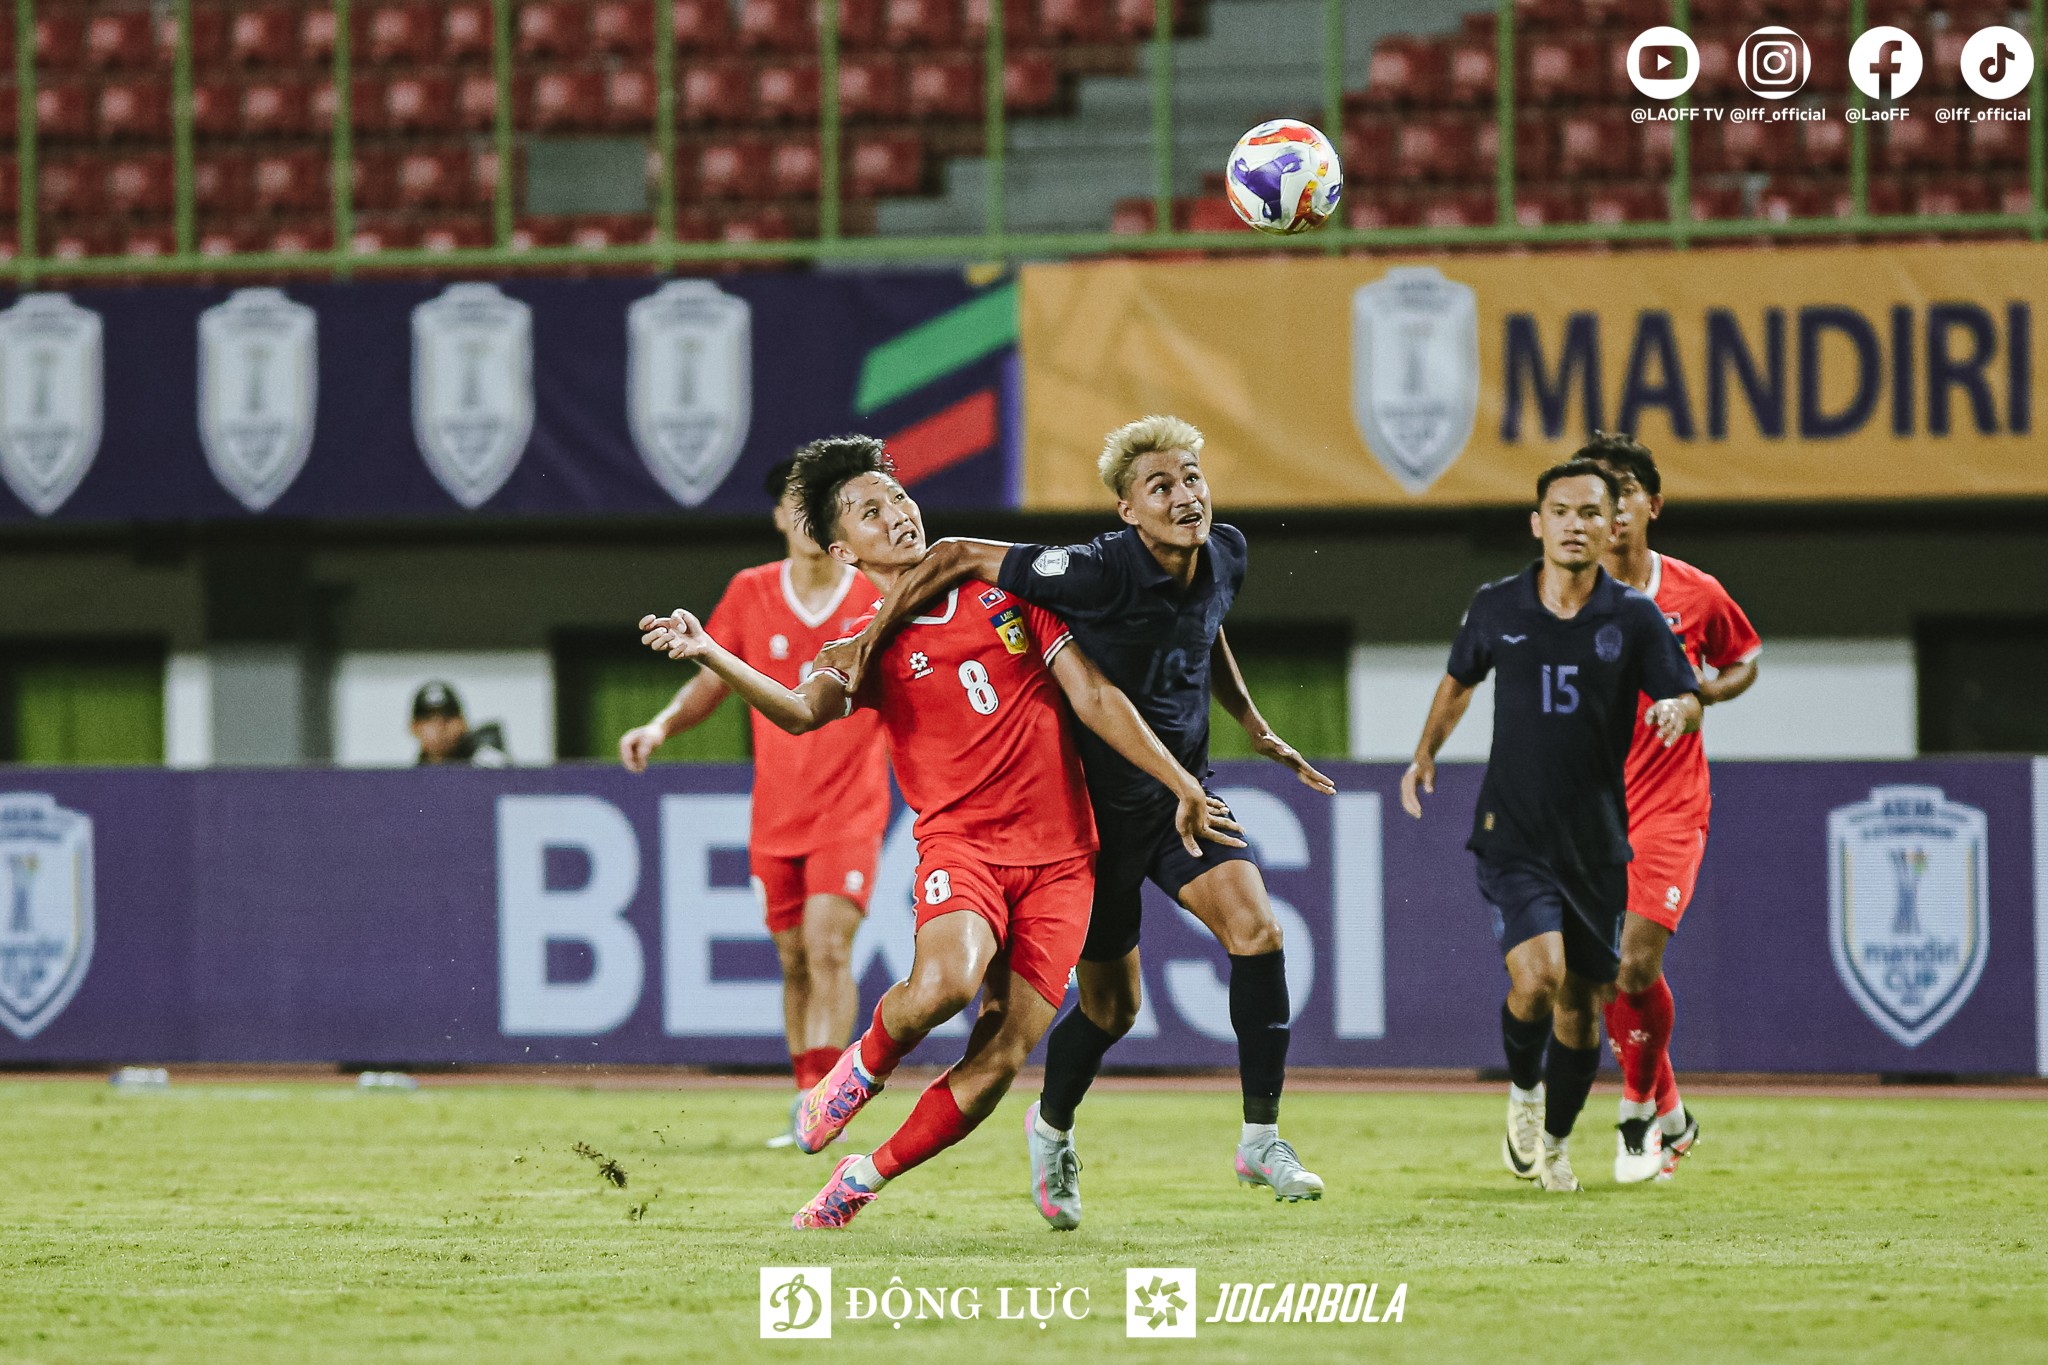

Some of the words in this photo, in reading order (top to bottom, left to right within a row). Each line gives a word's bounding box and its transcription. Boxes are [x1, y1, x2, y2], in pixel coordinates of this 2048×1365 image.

[1500, 301, 2033, 444] MANDIRI
[957, 659, 999, 716] 8
[1541, 664, 1580, 714] 15
[497, 786, 1387, 1042] BESI
[924, 868, 952, 905] 8
